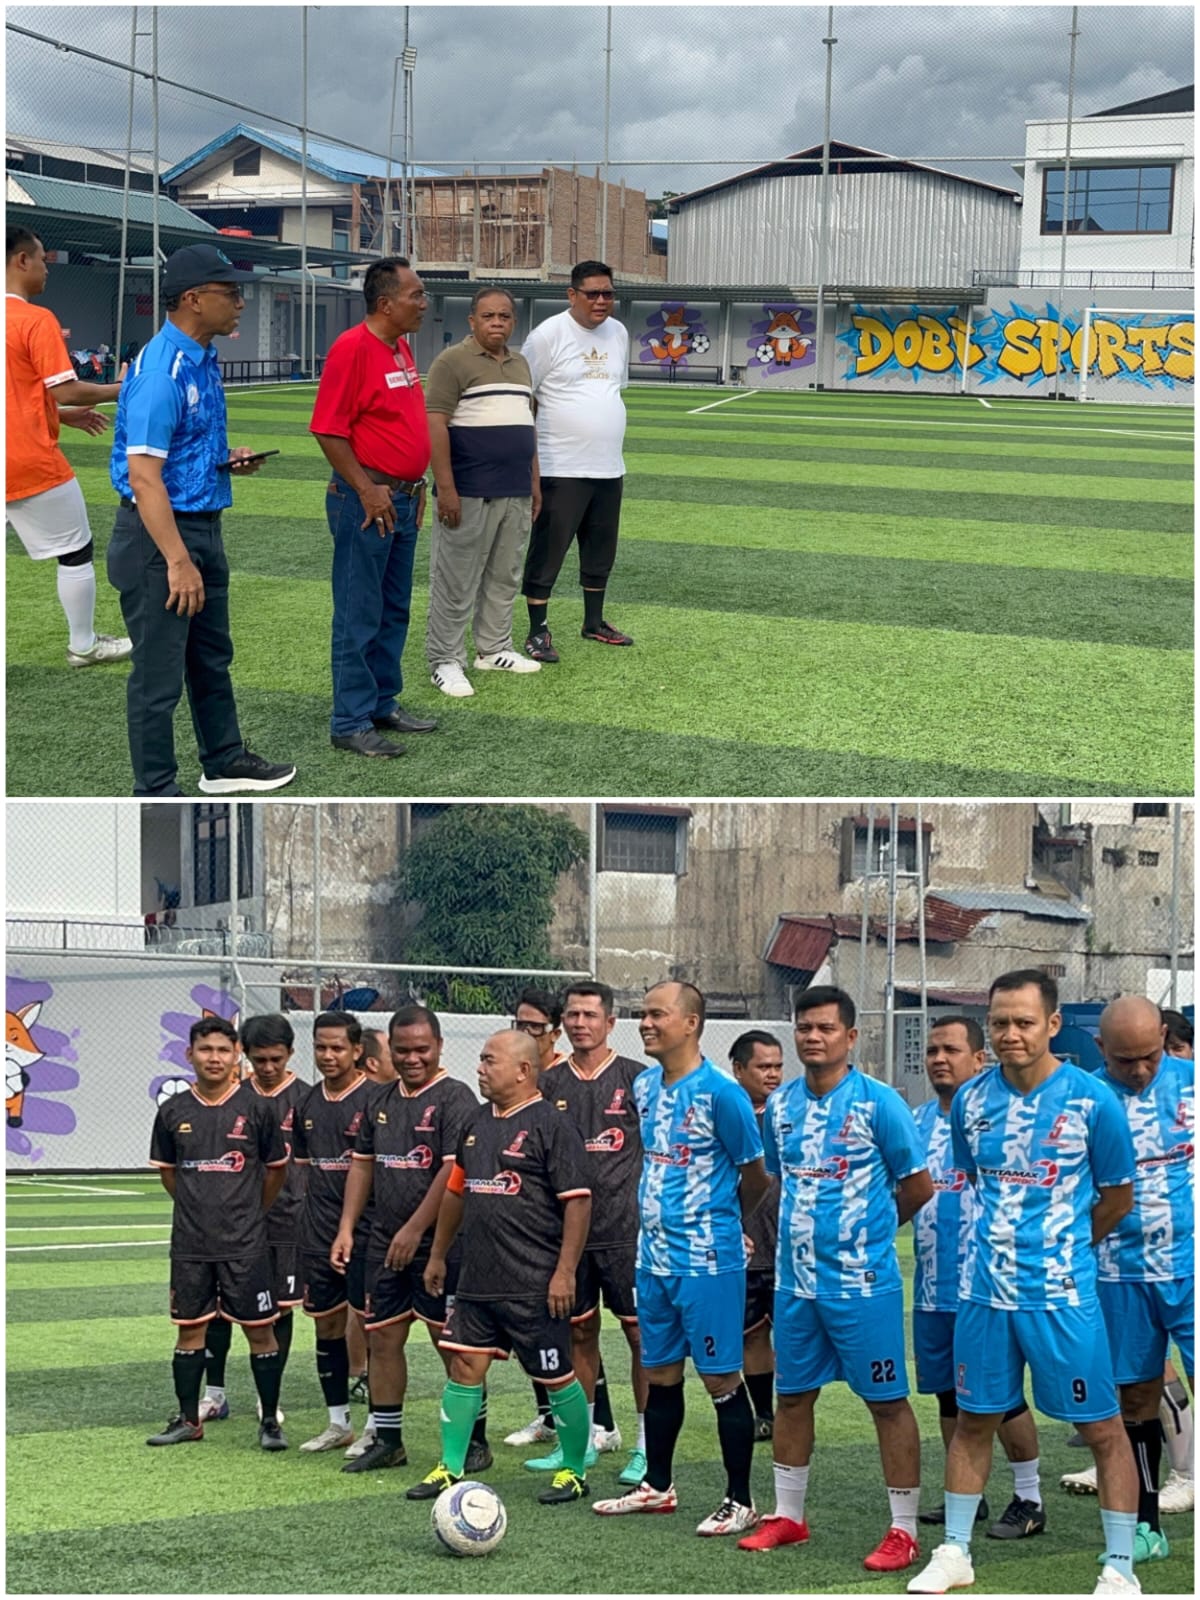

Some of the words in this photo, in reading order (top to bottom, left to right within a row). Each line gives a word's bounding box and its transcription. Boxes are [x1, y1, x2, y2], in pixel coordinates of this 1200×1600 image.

[998, 317, 1194, 380] SPORTS
[999, 1175, 1038, 1186] TURBO
[287, 1275, 296, 1294] 7
[256, 1290, 273, 1312] 21
[704, 1335, 716, 1358] 2
[539, 1348, 560, 1371] 13
[870, 1359, 896, 1384] 22
[1071, 1376, 1087, 1405] 9
